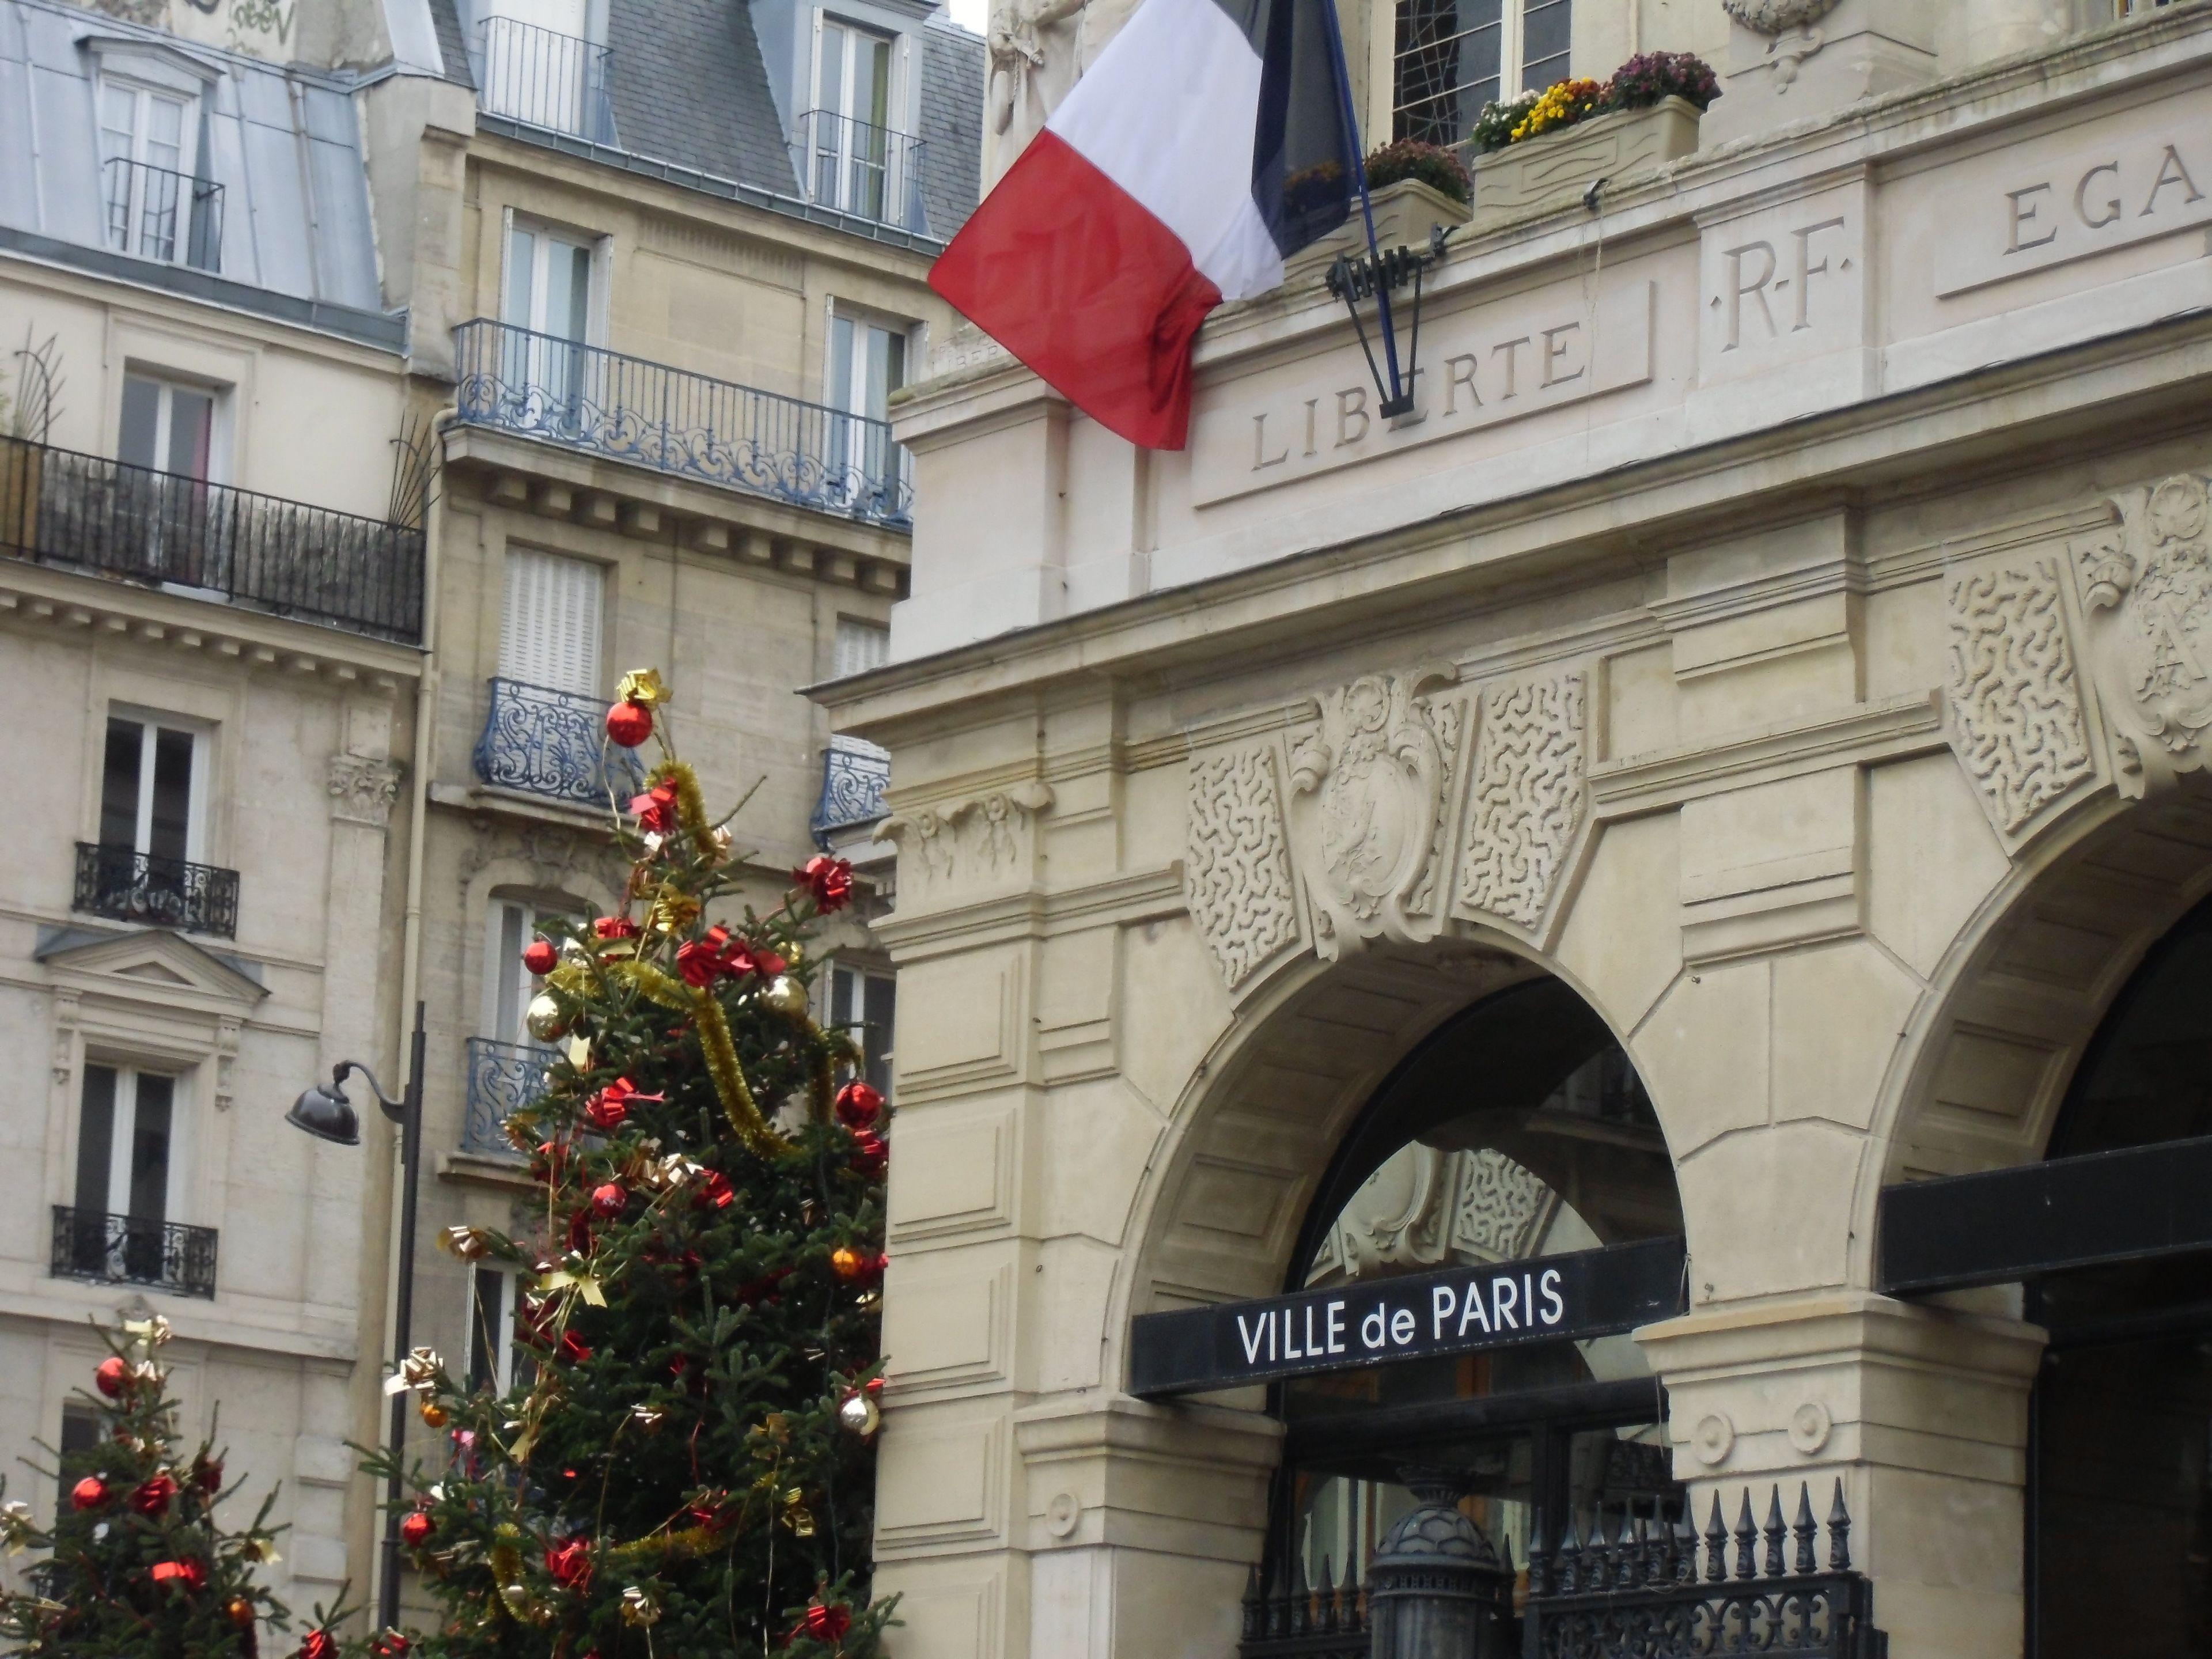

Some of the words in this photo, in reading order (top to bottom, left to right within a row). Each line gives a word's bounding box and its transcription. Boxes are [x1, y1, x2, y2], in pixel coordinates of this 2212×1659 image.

[1237, 1300, 1347, 1365] VILLE
[1361, 1302, 1416, 1349] de
[1432, 1268, 1564, 1340] PARIS
